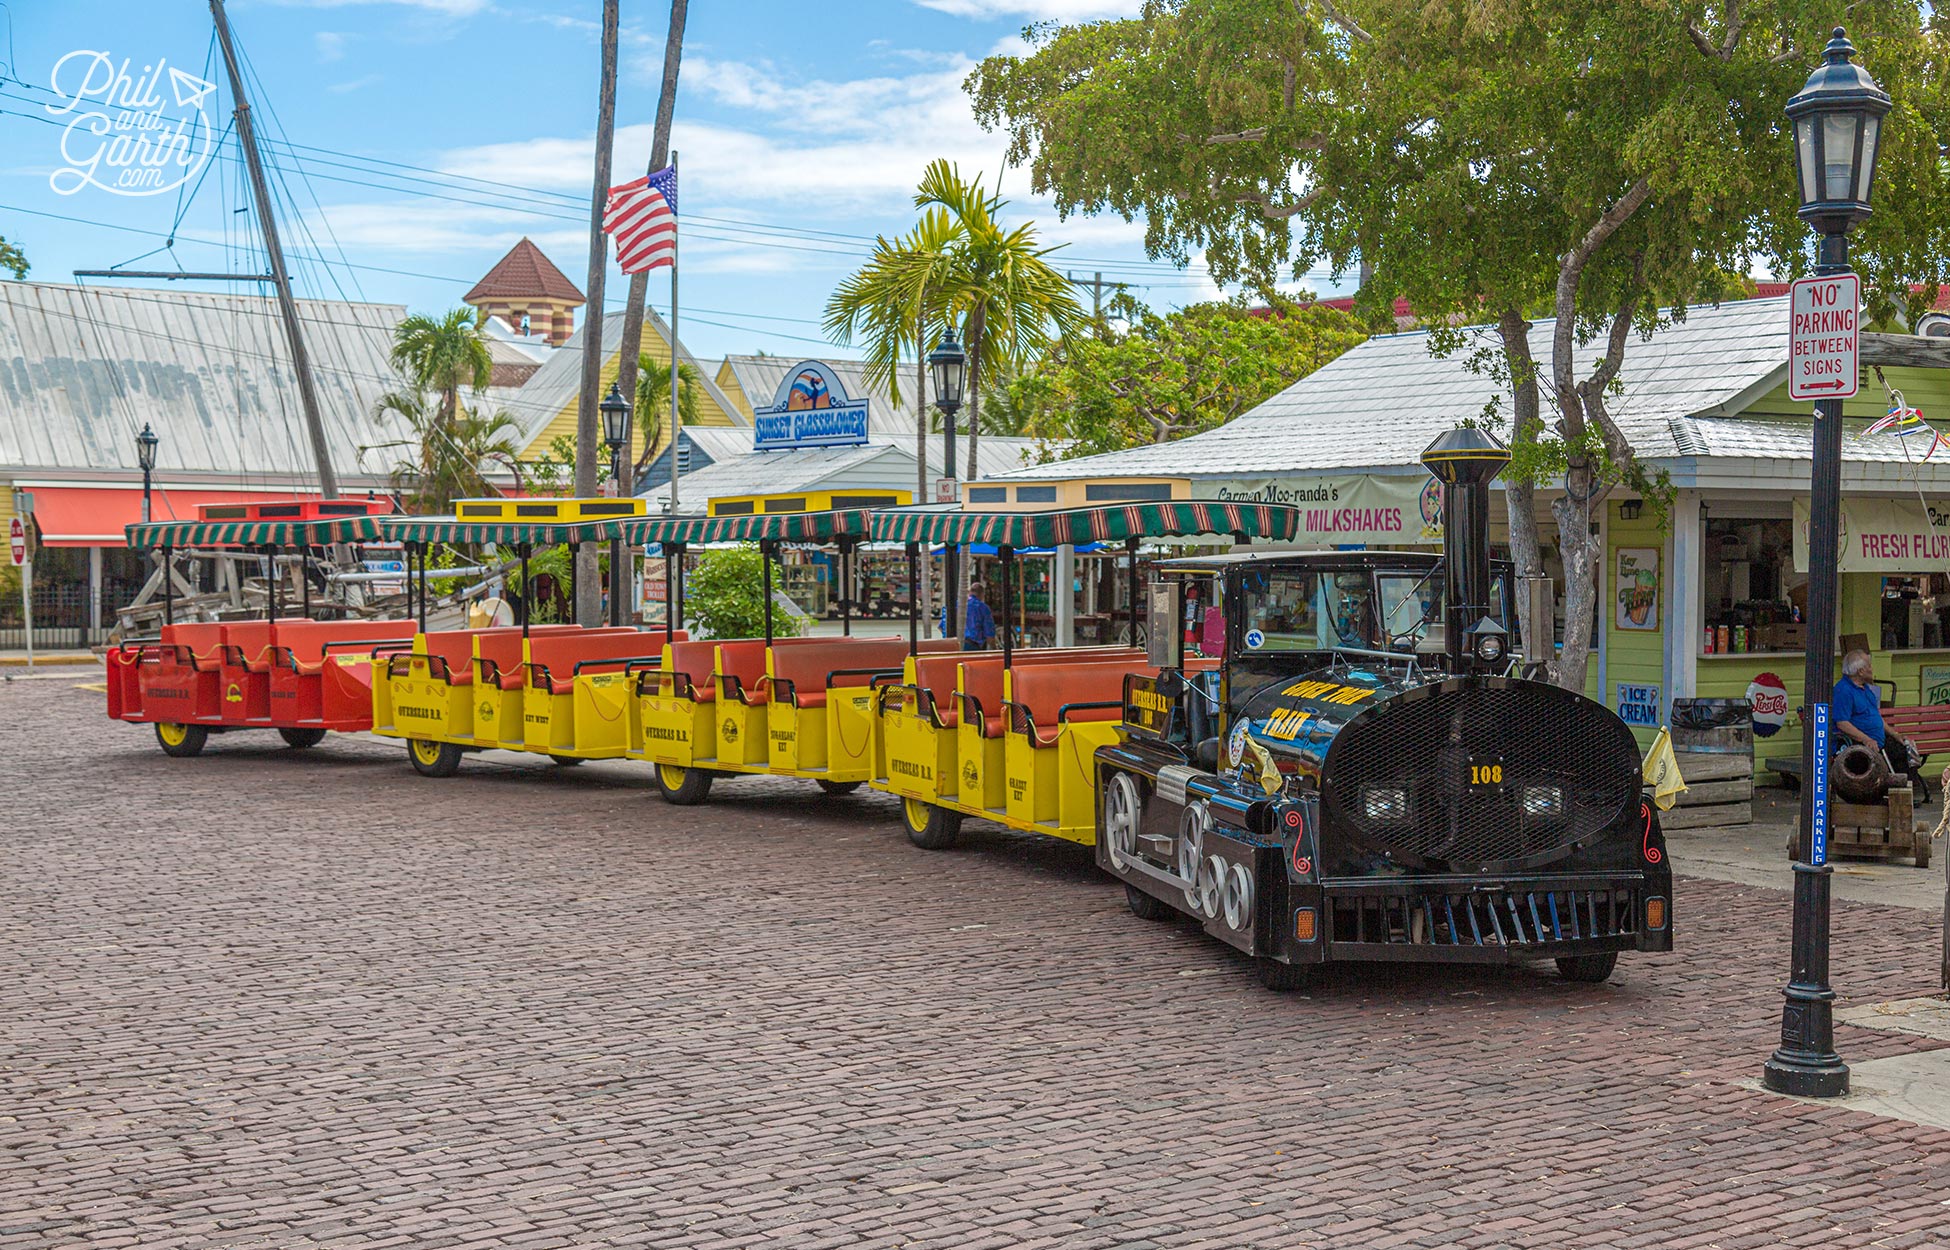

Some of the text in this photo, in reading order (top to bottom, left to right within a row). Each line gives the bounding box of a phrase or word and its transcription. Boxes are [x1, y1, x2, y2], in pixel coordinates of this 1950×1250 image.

[1812, 284, 1837, 307] NO
[1795, 309, 1853, 335] PARKING
[1795, 337, 1853, 356] BETWEEN
[1803, 358, 1842, 376] SIGNS
[755, 410, 865, 443] SUNSET GLASSBLOWER
[1217, 484, 1339, 502] Carmen Moo-randa's
[1306, 507, 1402, 532] MILKSHAKES
[1861, 533, 1909, 559] FRESH
[1629, 687, 1647, 701] ICE
[398, 706, 428, 720] OVERSEAS
[525, 714, 549, 724] KEY WEST
[1620, 703, 1657, 724] CREAM
[1261, 707, 1311, 740] TRAIN
[645, 726, 689, 742] OVERSEAS R.R.
[891, 758, 919, 778] OVERSEAS
[1471, 765, 1503, 785] 108
[1815, 706, 1826, 863] NO BICYCLE PARKING
